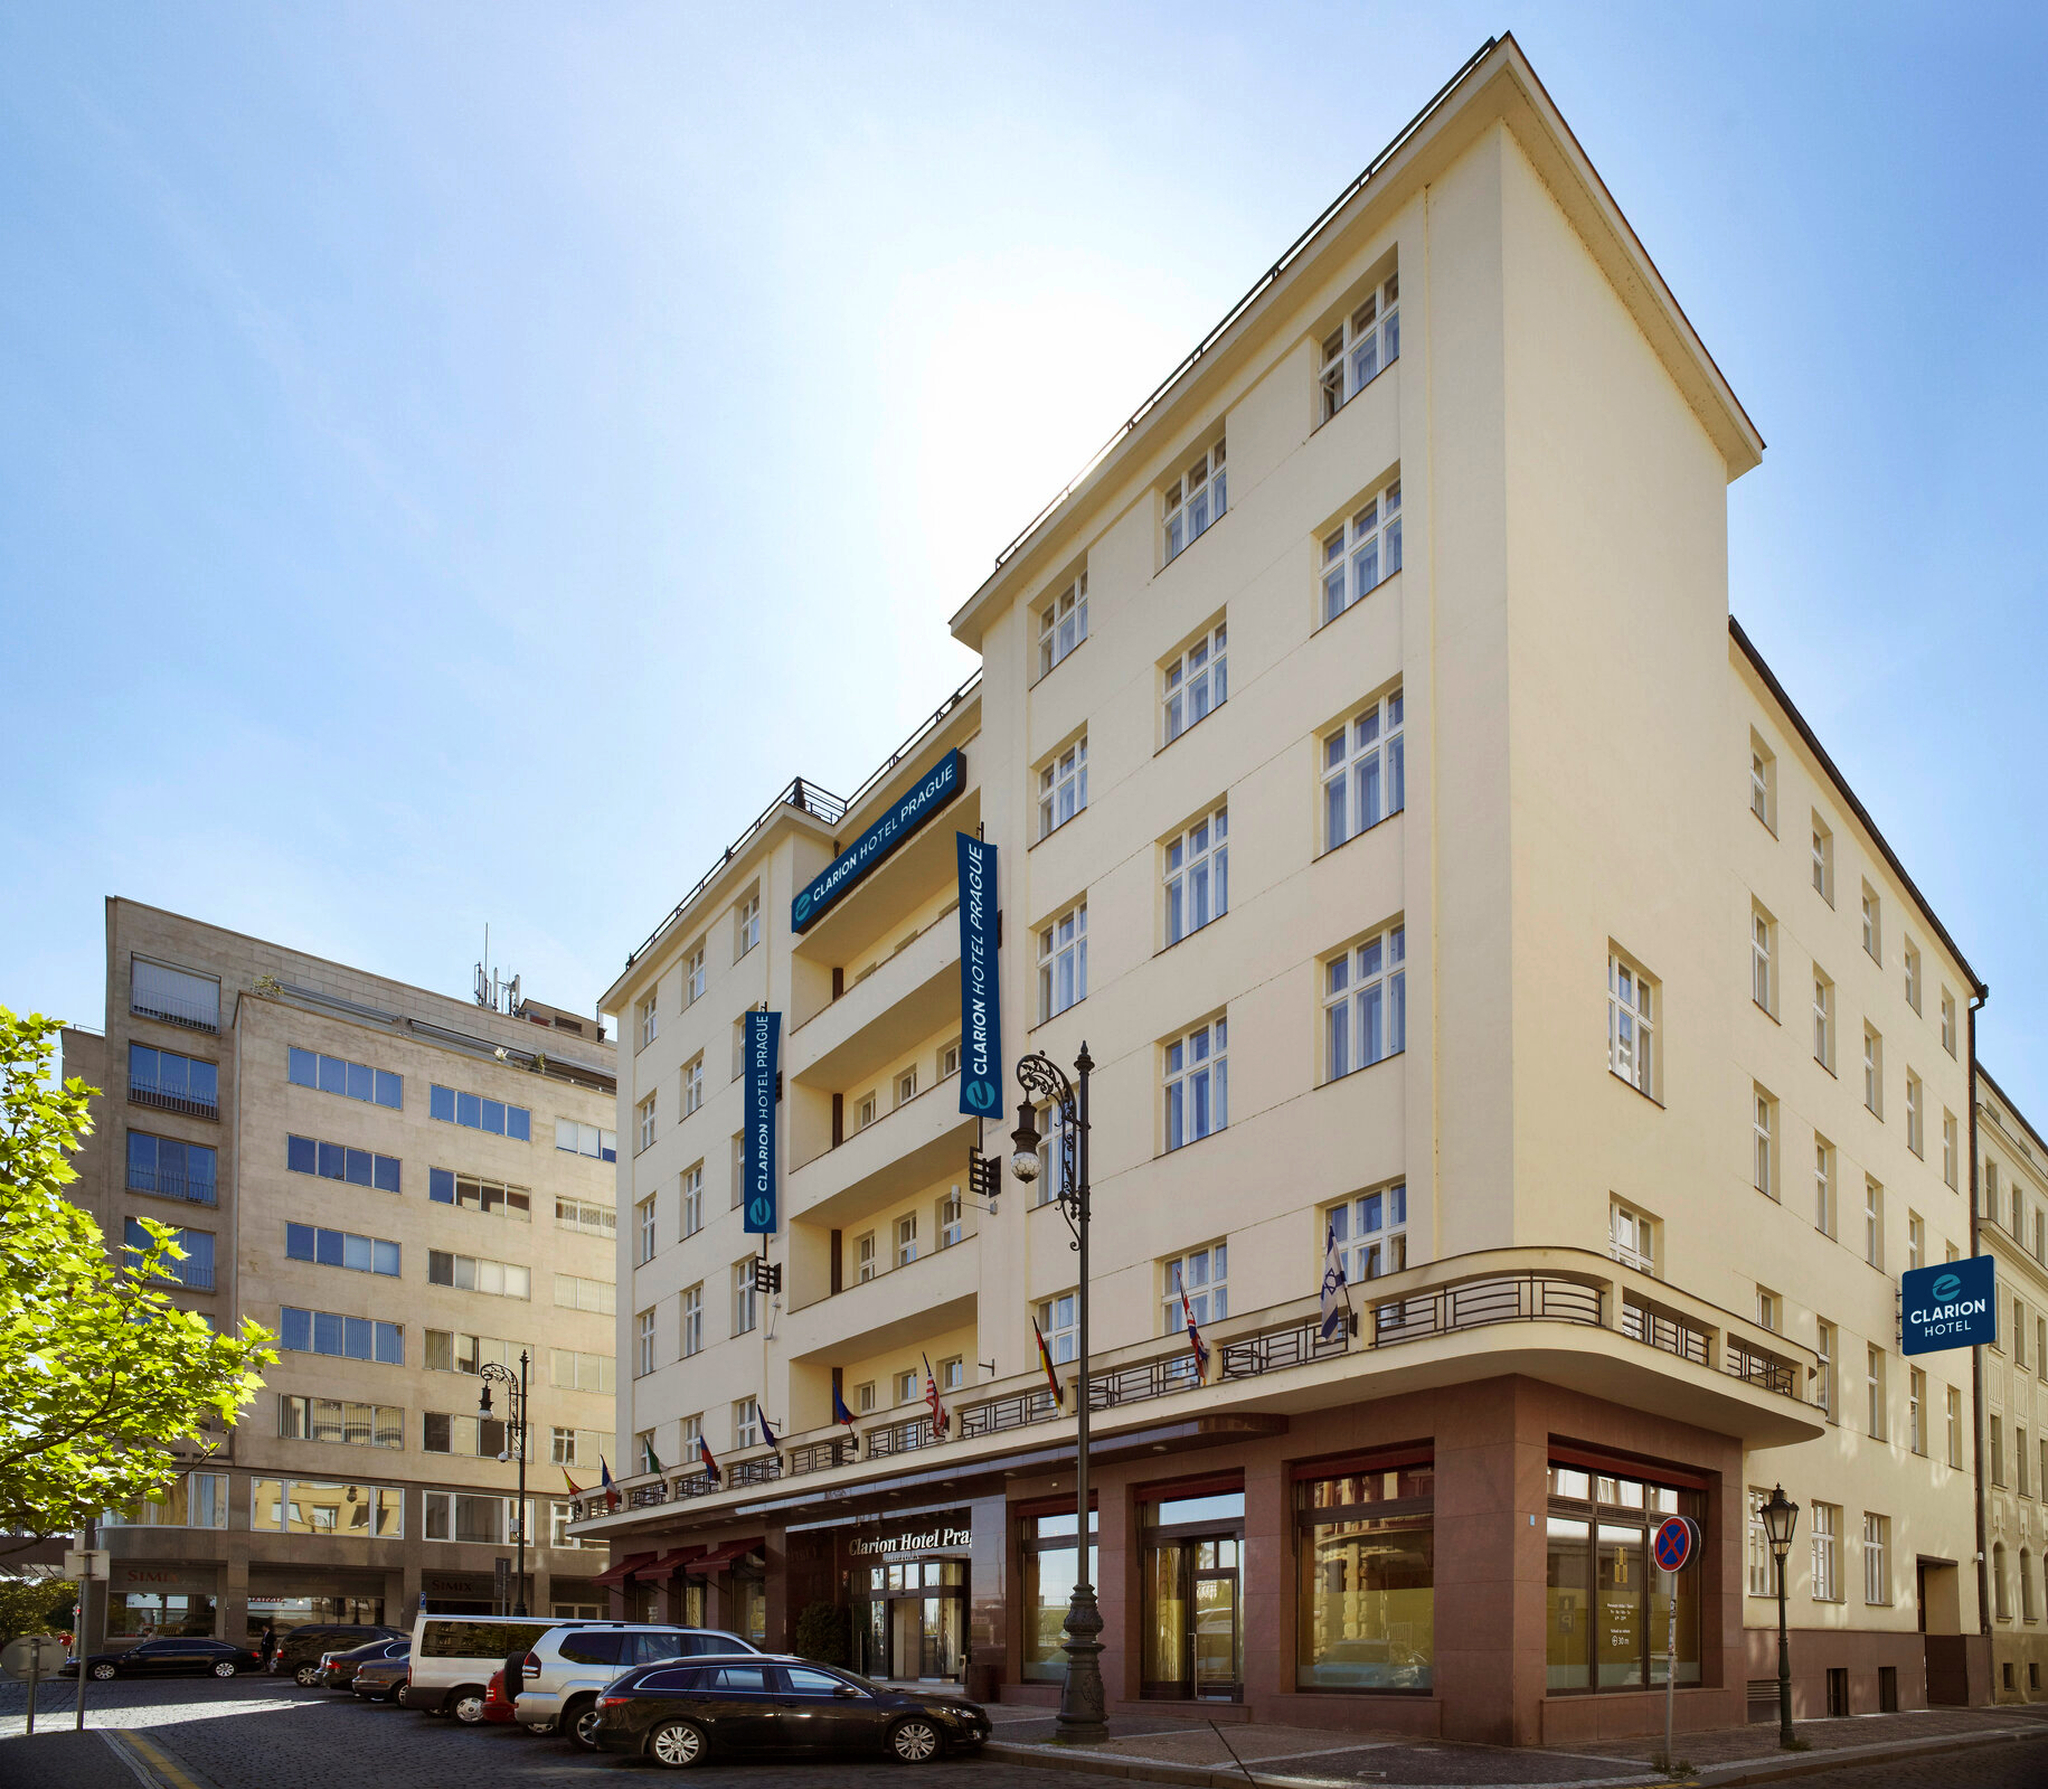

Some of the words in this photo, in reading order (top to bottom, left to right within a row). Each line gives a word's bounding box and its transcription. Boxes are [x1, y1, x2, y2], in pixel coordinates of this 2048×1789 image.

[813, 853, 857, 902] CLARION
[860, 818, 898, 860] HOTEL
[901, 763, 953, 822] PRAGUE
[968, 843, 983, 931] PRAGUE
[971, 934, 985, 996] HOTEL
[756, 1015, 769, 1068] PRAGUE
[972, 998, 988, 1075] CLARION
[757, 1071, 769, 1119] HOTEL
[757, 1123, 769, 1192] CLARION
[1910, 1298, 1986, 1325] CLARION
[1924, 1319, 1972, 1338] HOTEL
[848, 1536, 897, 1556] Clarion
[900, 1528, 940, 1551] Hotel
[431, 1579, 474, 1592] SIMIX
